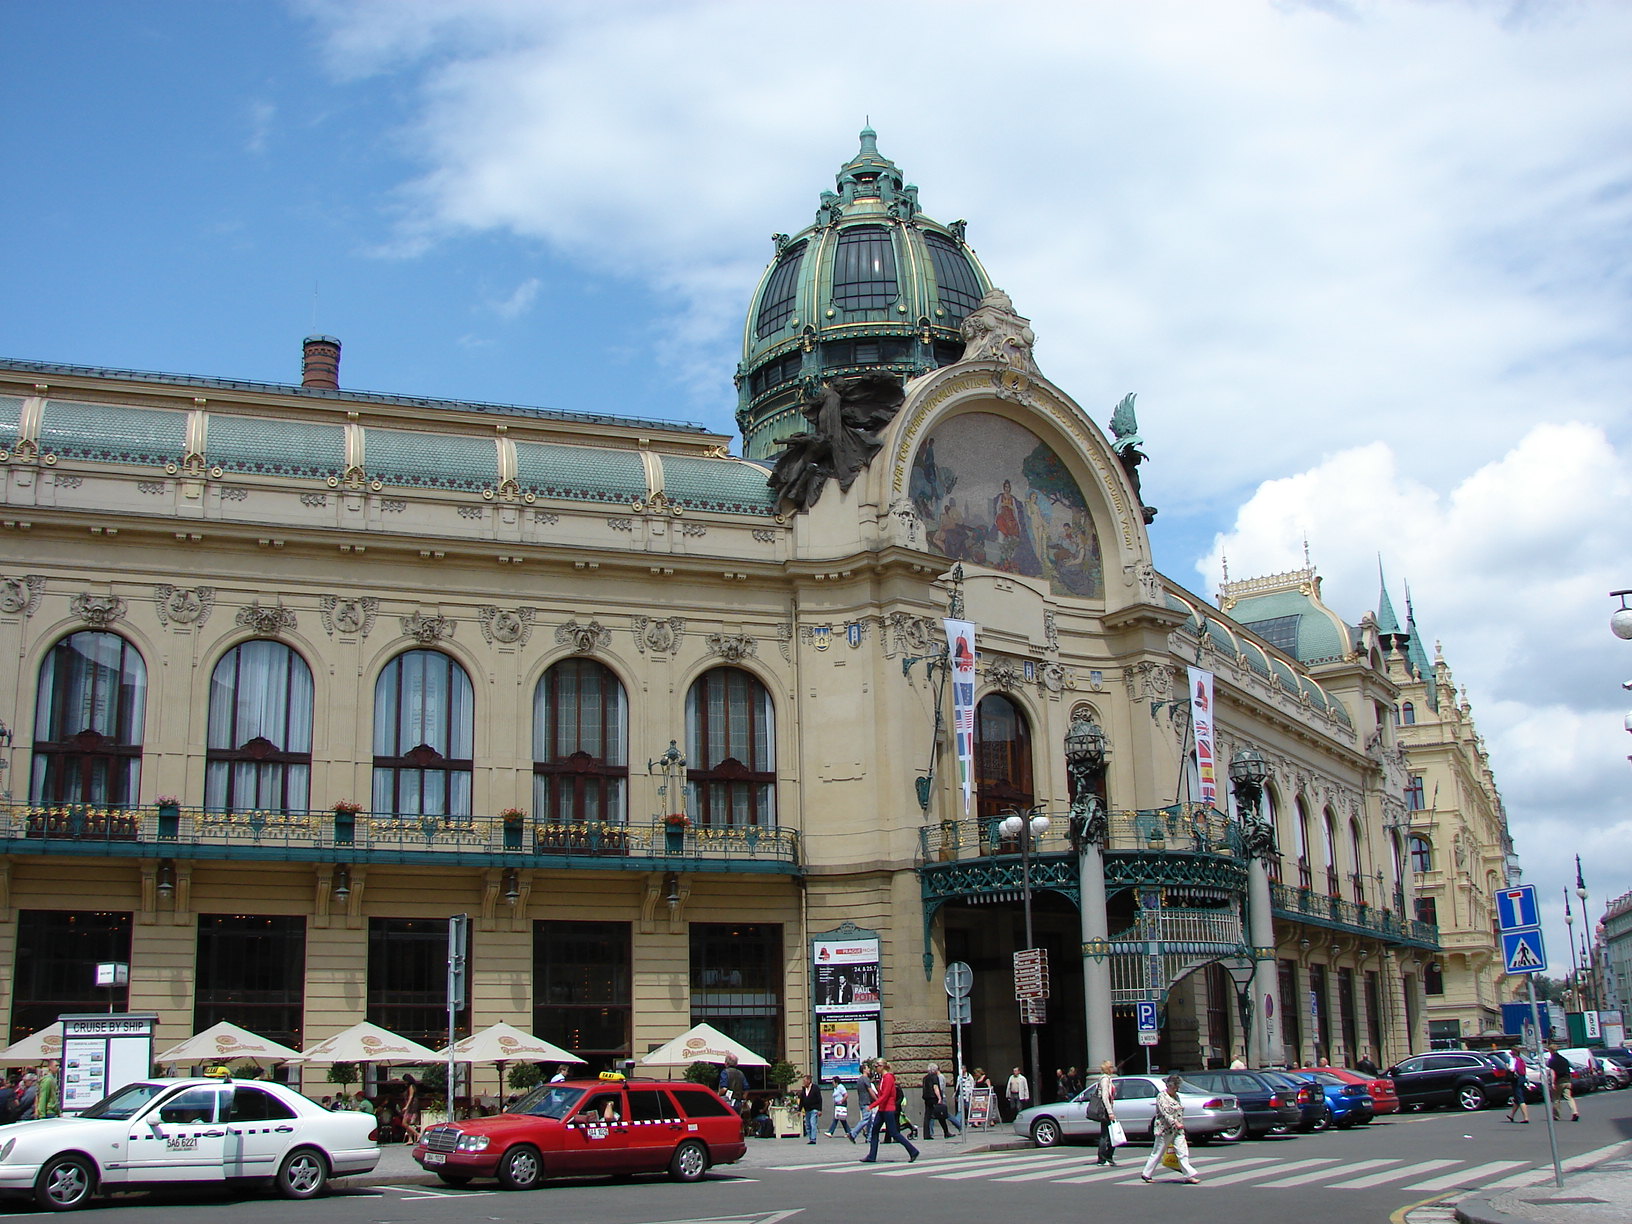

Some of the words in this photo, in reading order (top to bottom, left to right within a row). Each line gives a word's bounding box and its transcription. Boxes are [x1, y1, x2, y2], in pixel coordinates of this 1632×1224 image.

[854, 992, 879, 1001] POTTS
[1141, 1005, 1152, 1022] P
[73, 1022, 107, 1033] CRUISE
[109, 1022, 121, 1032] BY
[123, 1021, 144, 1032] SHIP
[820, 1043, 861, 1060] FOK
[167, 1138, 180, 1148] 5A6
[181, 1138, 198, 1147] 6221
